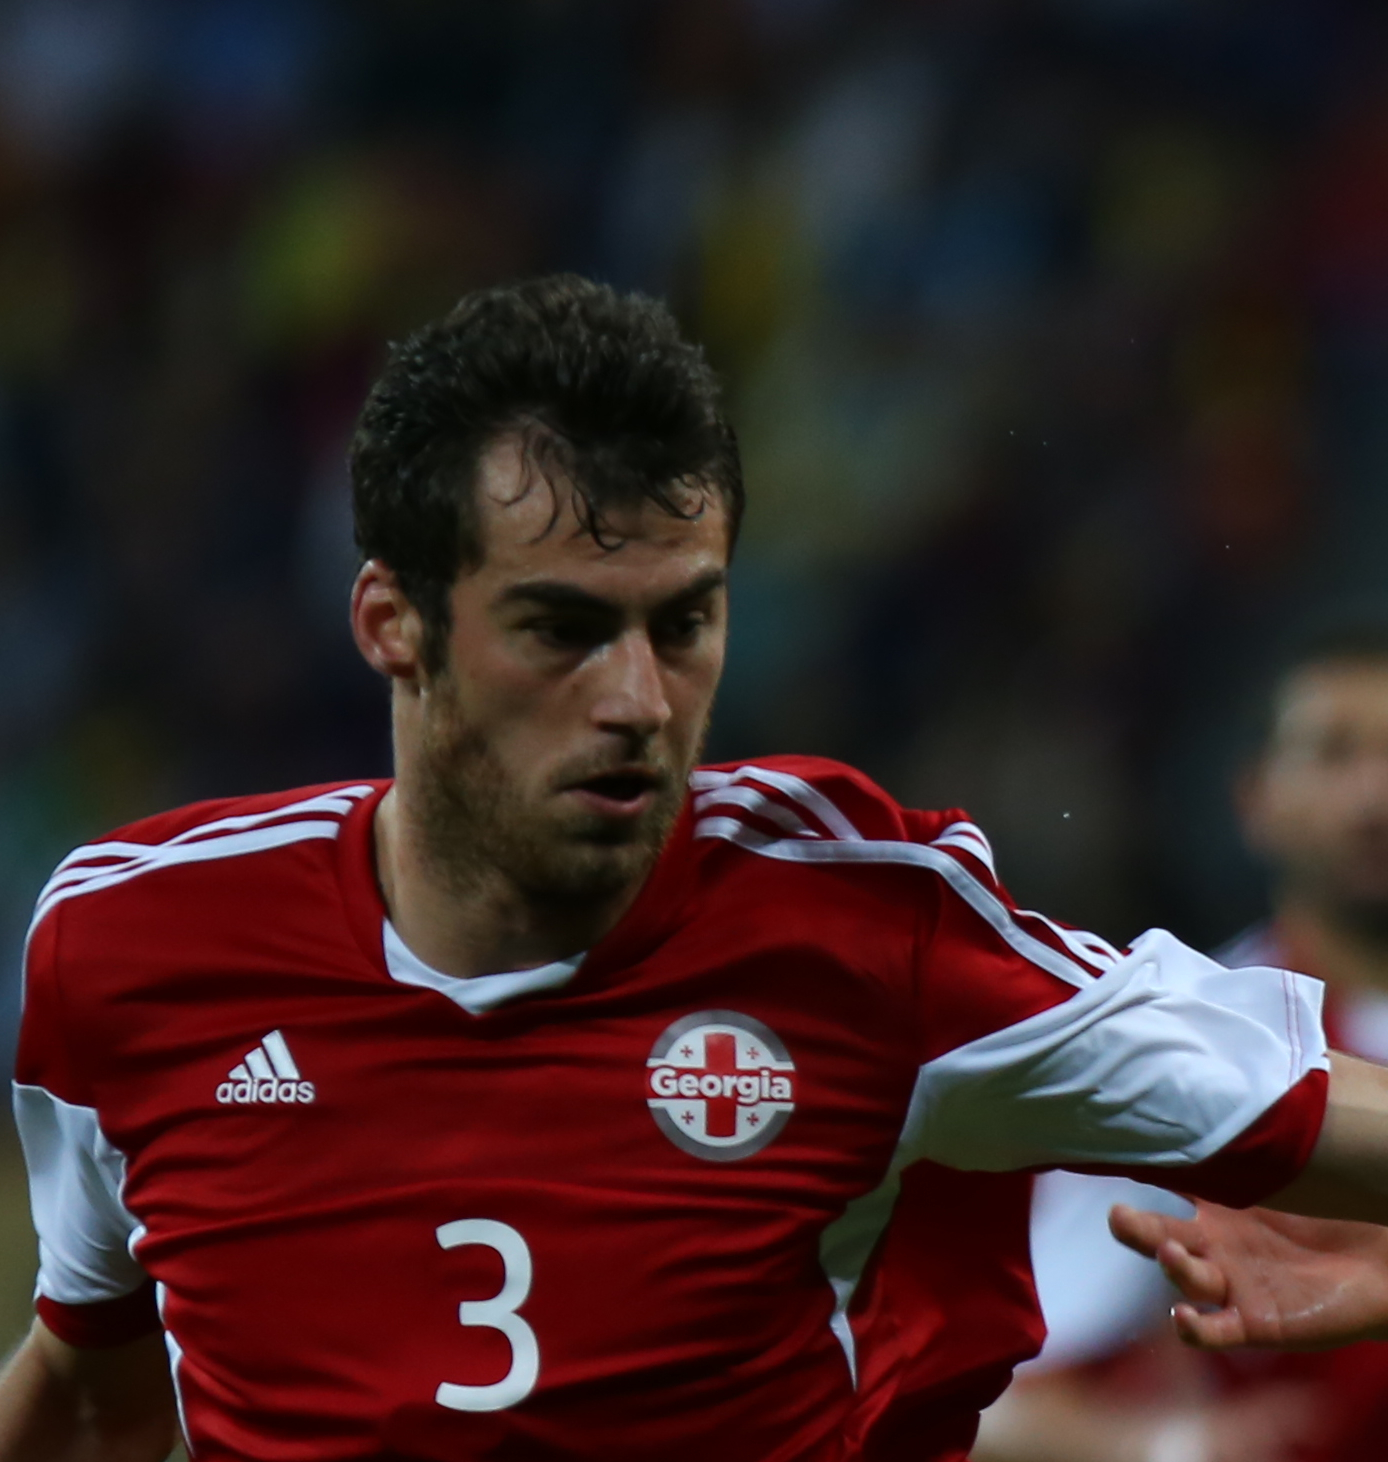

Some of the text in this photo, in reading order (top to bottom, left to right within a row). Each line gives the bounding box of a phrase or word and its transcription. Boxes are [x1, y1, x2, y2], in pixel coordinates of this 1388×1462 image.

[216, 1077, 315, 1104] adidas
[650, 1067, 792, 1106] Georgia
[435, 1218, 540, 1412] 3
